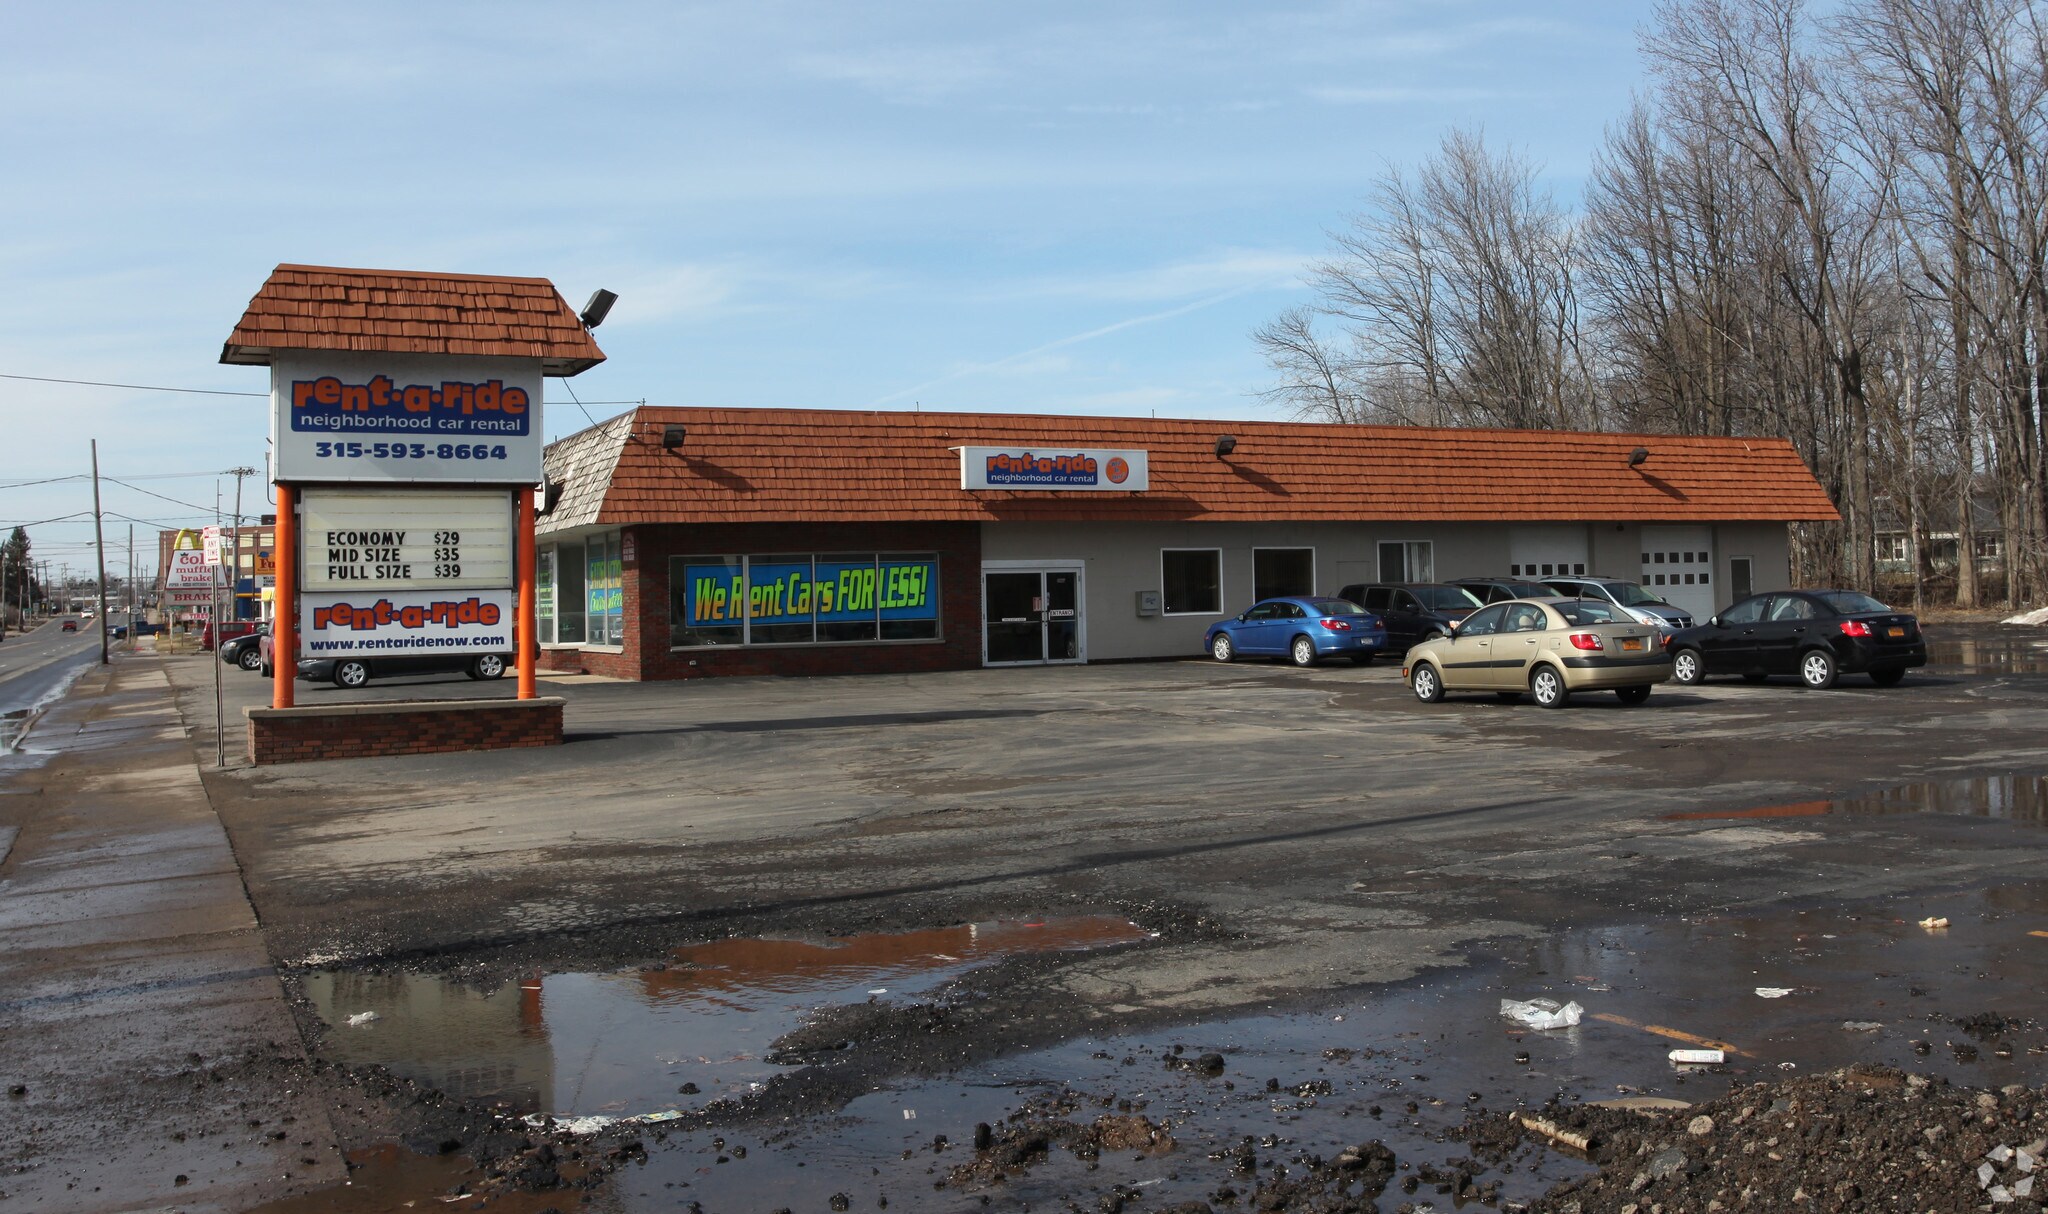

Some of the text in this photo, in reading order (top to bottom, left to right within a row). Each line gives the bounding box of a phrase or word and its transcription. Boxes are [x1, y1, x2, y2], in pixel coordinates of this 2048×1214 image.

[301, 413, 520, 431] neighborhood car rental
[316, 441, 507, 460] 315-593-8664
[991, 473, 1052, 483] neighborhood
[1069, 475, 1094, 483] rental
[327, 531, 460, 546] ECONOMY $29
[328, 548, 460, 562] MID SIZE $35
[328, 564, 461, 580] FULL SIZE $39
[694, 565, 928, 621] We Rent Cars FOR LESS!
[310, 635, 505, 651] www.rentaridenow.com
